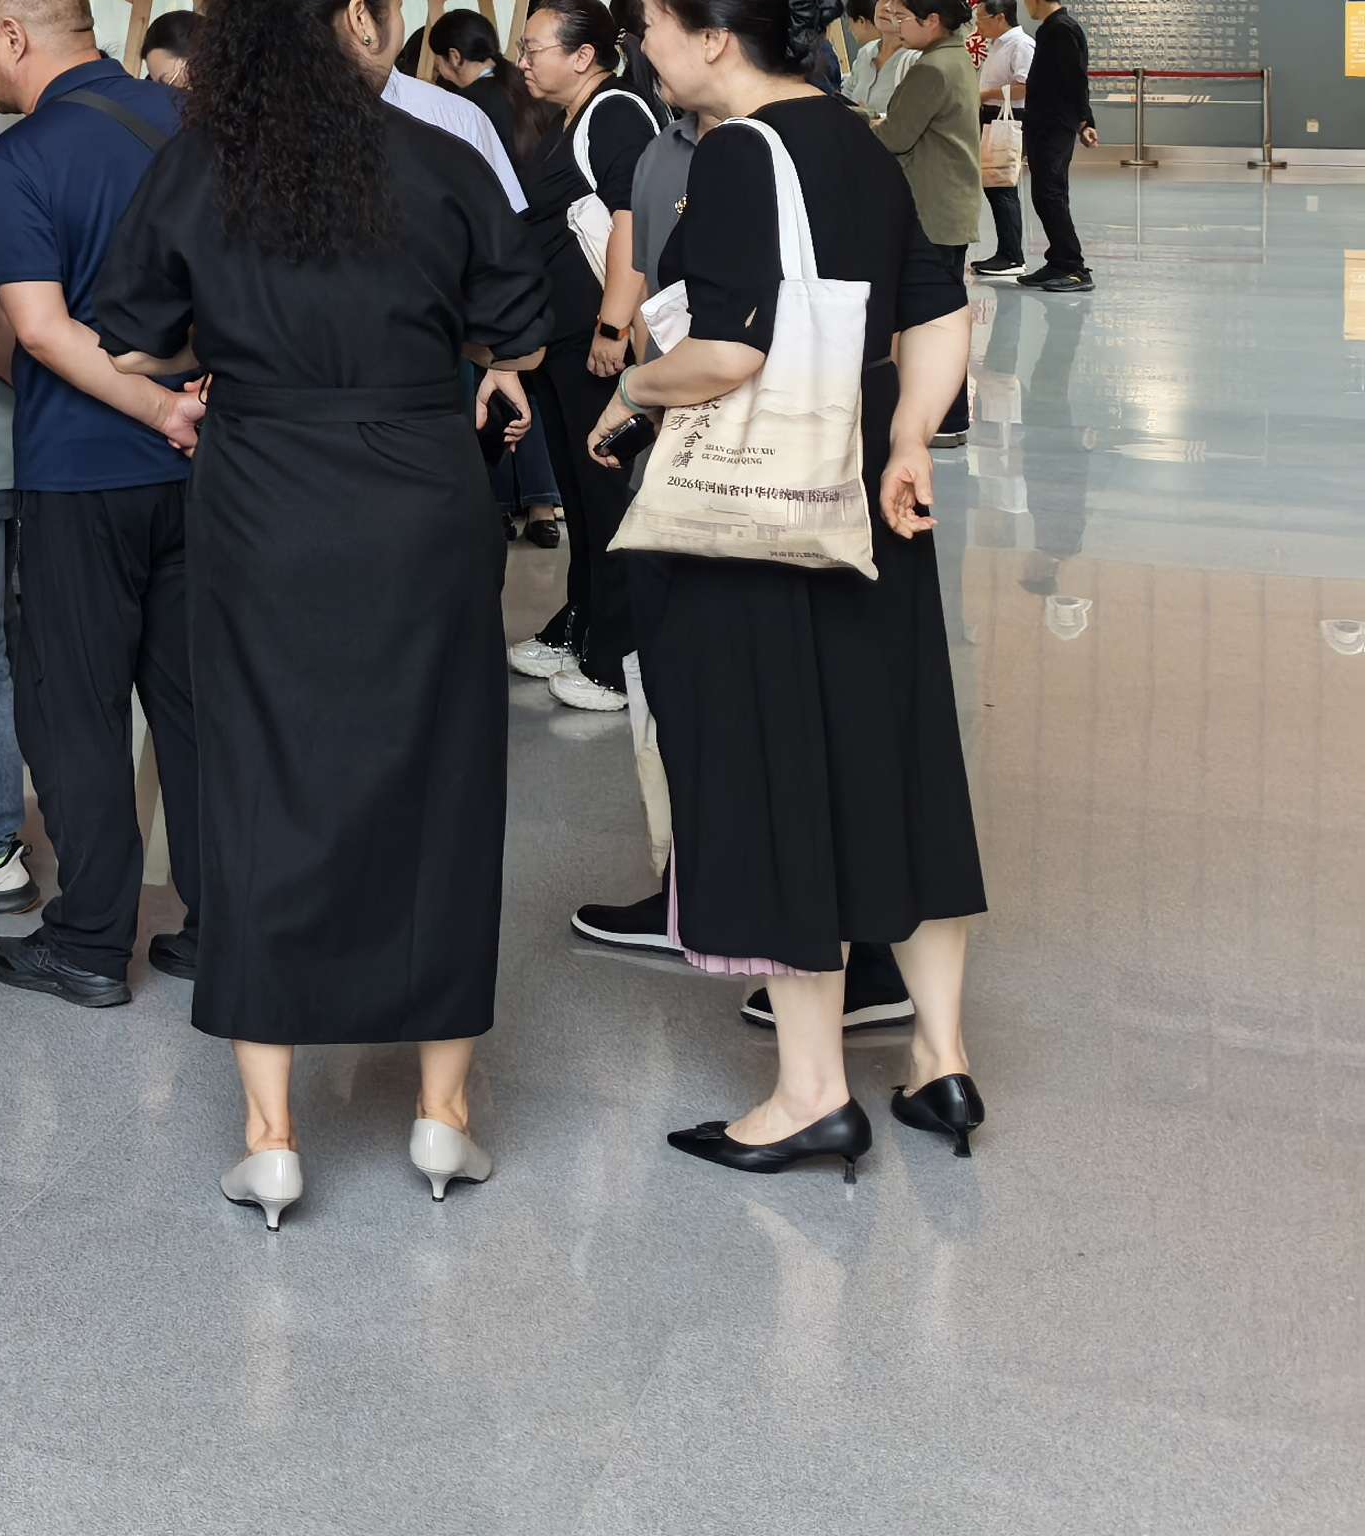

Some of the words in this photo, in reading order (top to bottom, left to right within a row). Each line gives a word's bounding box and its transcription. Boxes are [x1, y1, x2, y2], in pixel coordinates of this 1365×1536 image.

[667, 475, 840, 503] 2026年河南省中华传统晒书活动
